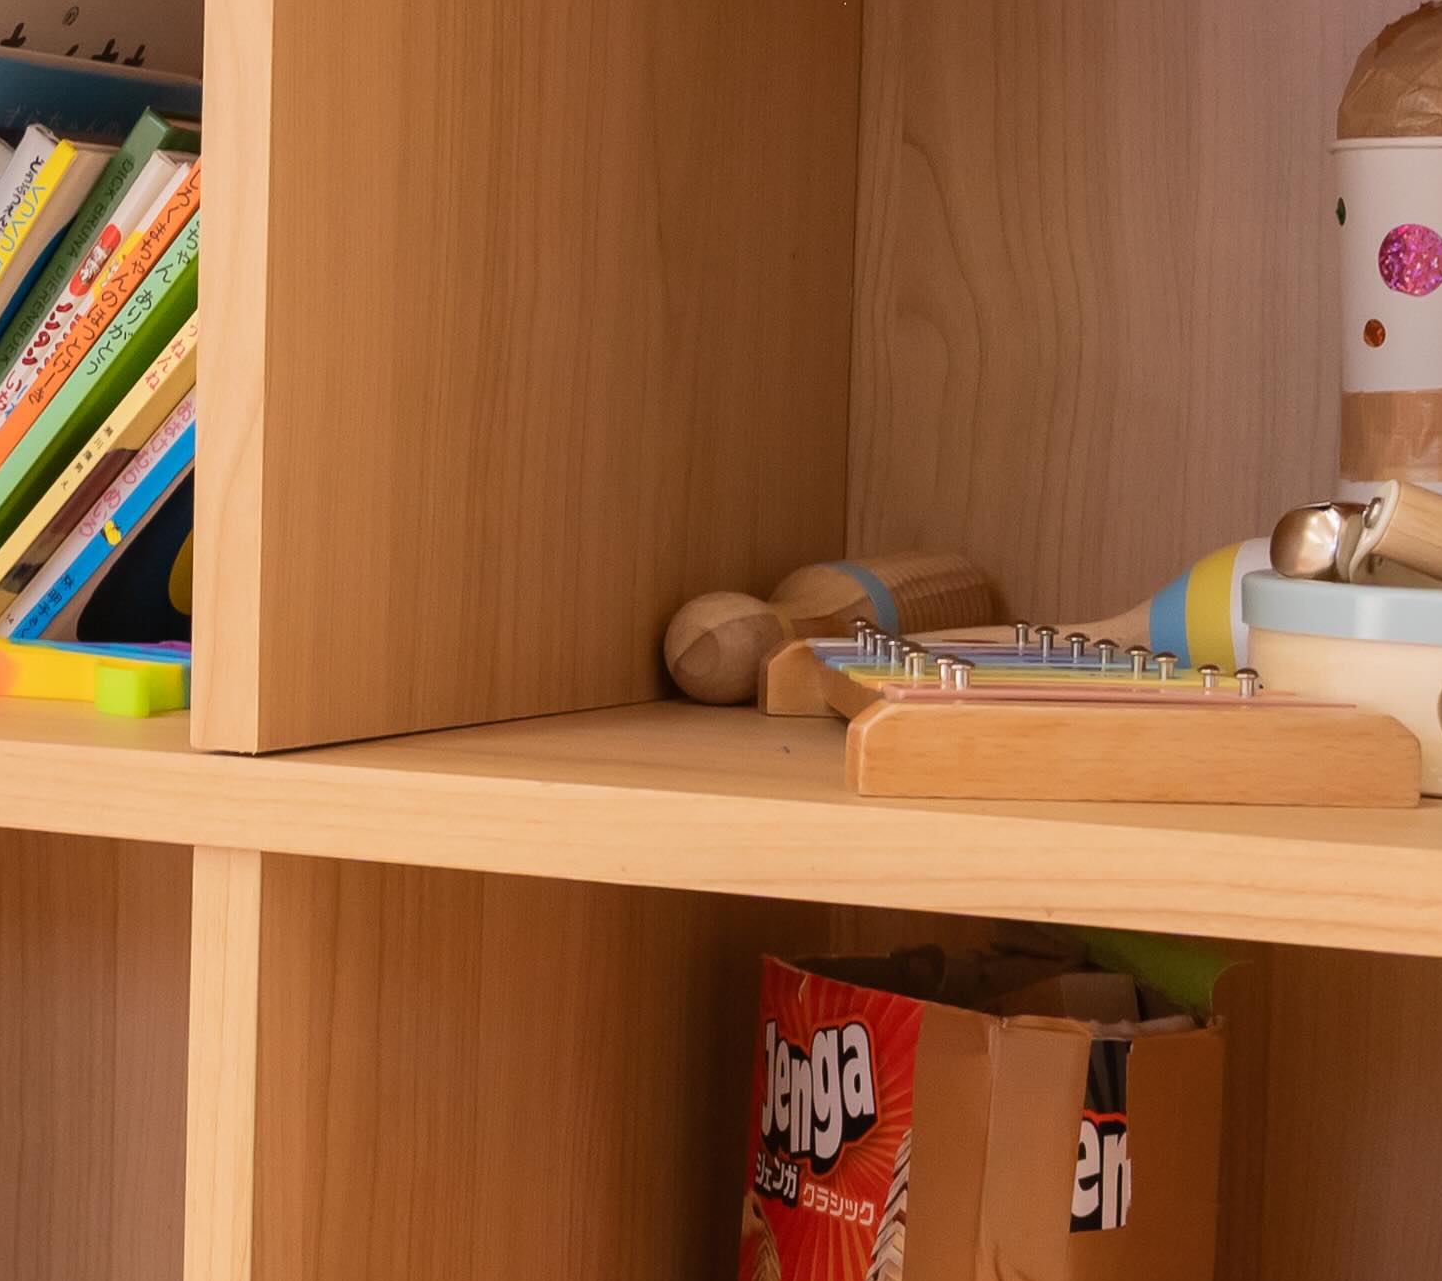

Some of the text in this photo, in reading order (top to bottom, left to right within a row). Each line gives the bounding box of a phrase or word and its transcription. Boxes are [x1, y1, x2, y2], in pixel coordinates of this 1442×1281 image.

[28, 167, 201, 406] しろくまちゃんのほっとけーき
[22, 302, 74, 366] ノンタン
[86, 288, 152, 376] ありがとう
[760, 1020, 876, 1159] Jenga
[755, 1153, 799, 1201] ジェンガ
[803, 1181, 875, 1227] クラシック
